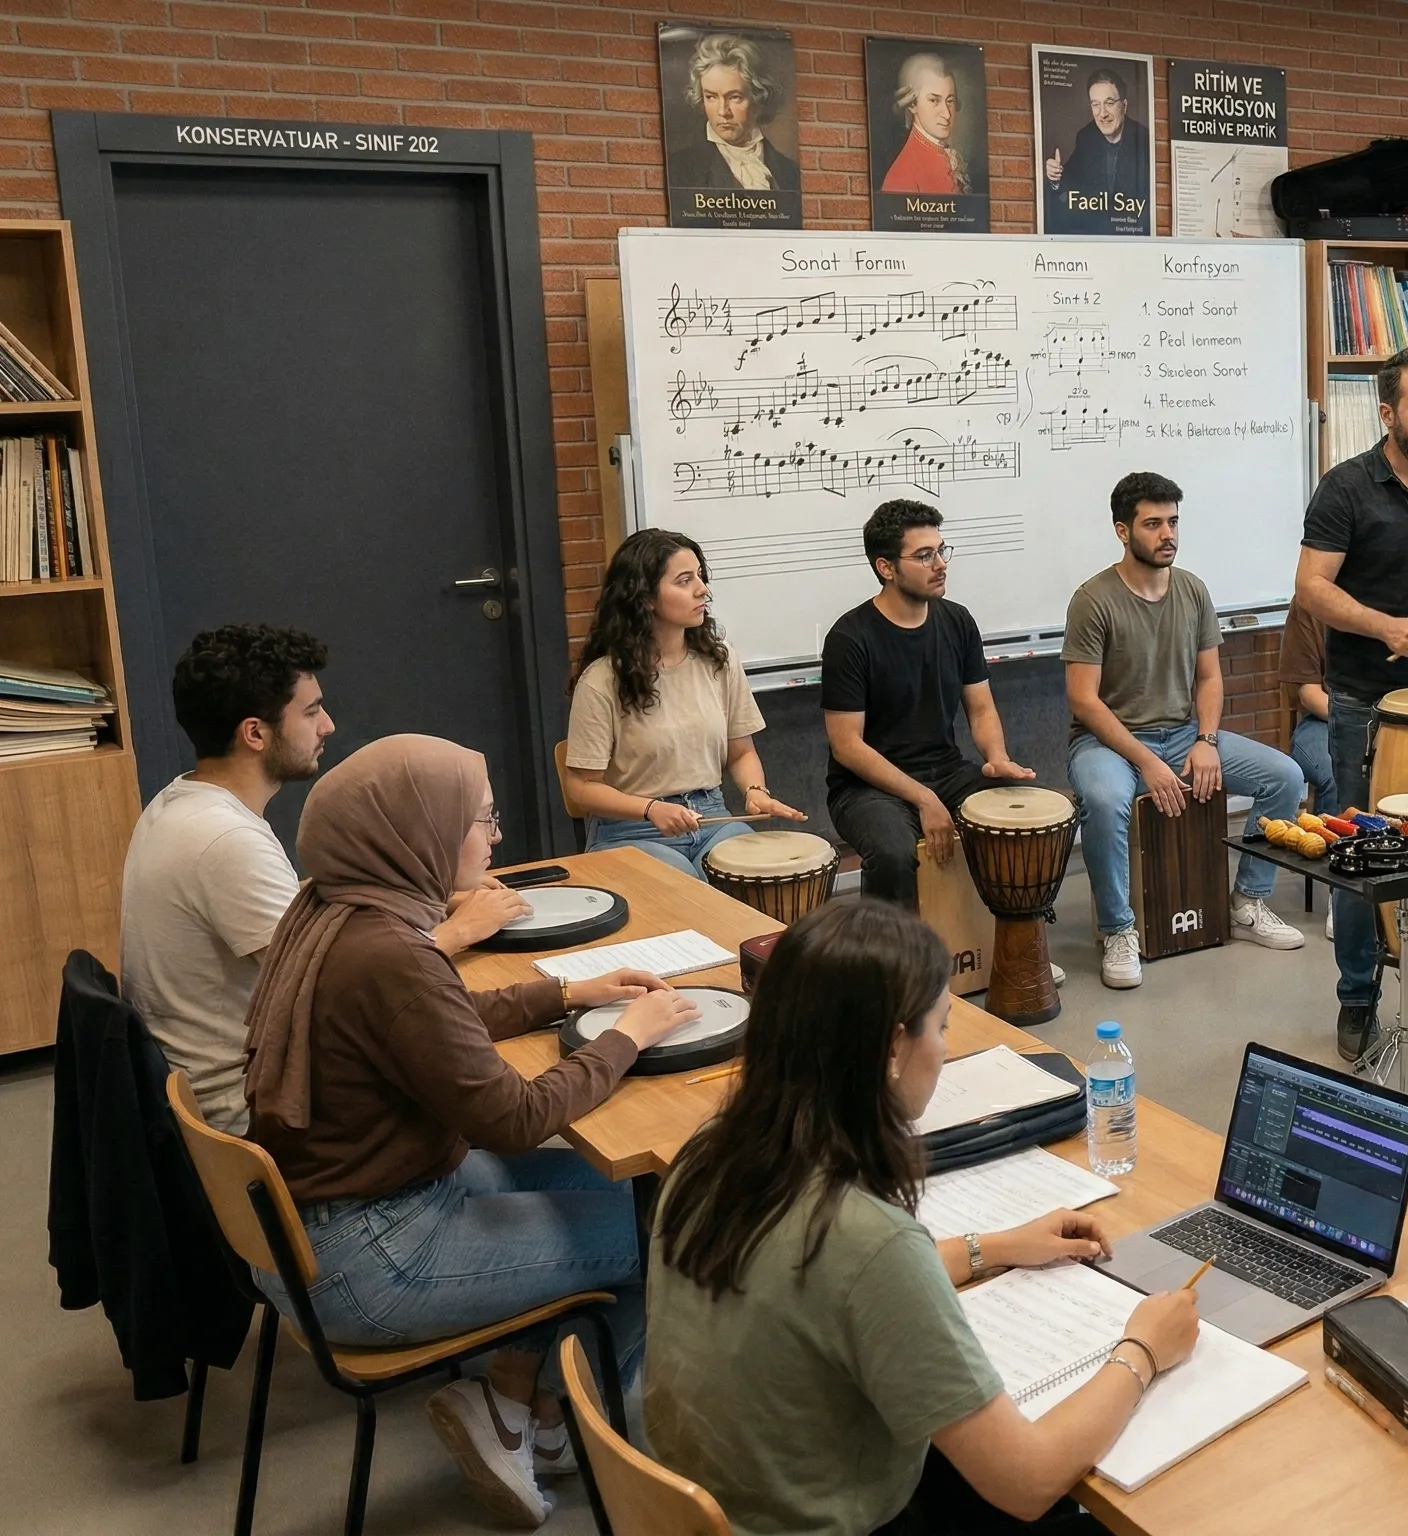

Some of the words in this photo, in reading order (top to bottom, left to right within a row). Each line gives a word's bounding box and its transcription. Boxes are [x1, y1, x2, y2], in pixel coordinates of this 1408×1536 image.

[1194, 69, 1238, 93] RİTİM
[1242, 77, 1263, 95] VE
[1181, 95, 1276, 119] PERKÜSYON
[176, 125, 339, 150] KONSERVATUAR
[355, 133, 404, 152] SINIF
[408, 136, 439, 153] 202
[1182, 119, 1217, 135] TEORİ
[1218, 122, 1234, 136] VE
[1236, 122, 1277, 139] PRATİK
[694, 193, 777, 210] Beethoven
[906, 198, 957, 213] Mozart
[1113, 192, 1146, 218] Say
[782, 250, 841, 272] Sonat
[1157, 300, 1195, 317] Sonat
